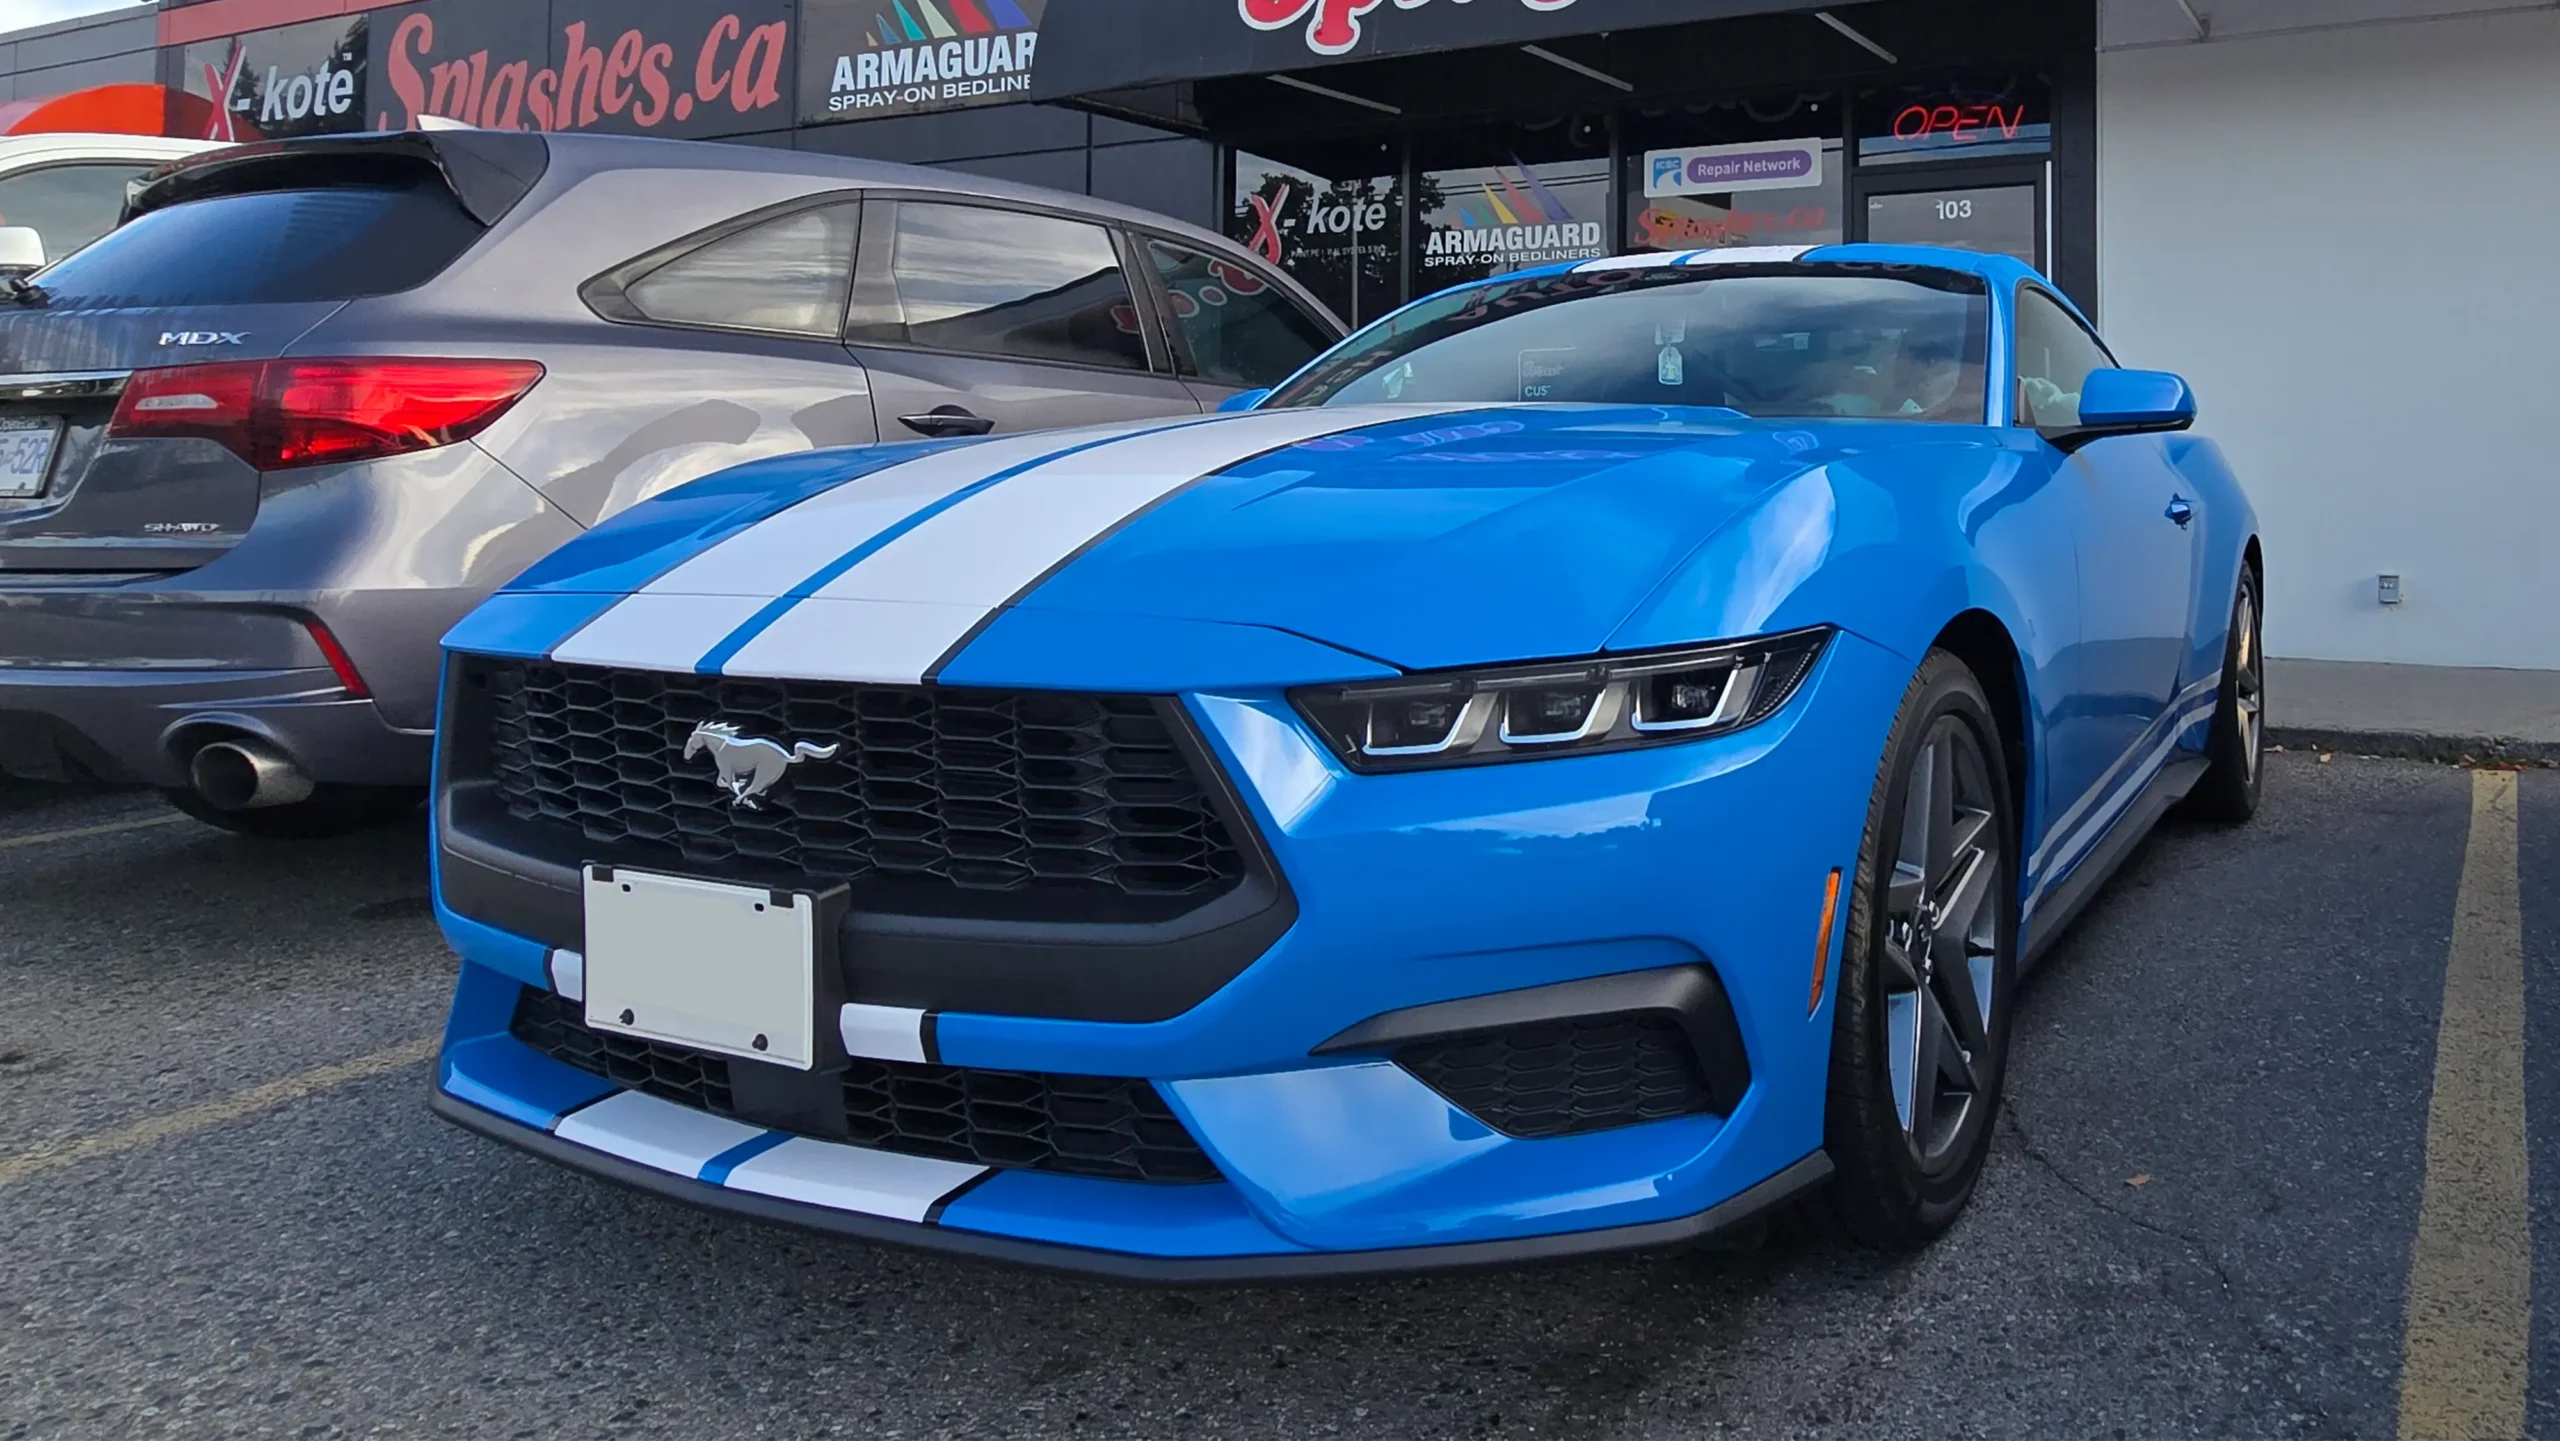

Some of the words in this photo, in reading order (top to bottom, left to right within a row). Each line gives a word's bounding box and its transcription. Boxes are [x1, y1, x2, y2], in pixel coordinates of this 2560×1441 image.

[378, 13, 787, 132] Splashes.ca
[831, 32, 1038, 92] ARMAGUAR
[260, 60, 354, 122] kote
[829, 86, 936, 111] SPRAY-ON
[943, 74, 1031, 99] BEDLINE
[1894, 105, 2024, 140] OPEN
[1698, 162, 1741, 177] Repair
[1744, 158, 1801, 173] Network
[1306, 196, 1387, 234] kote
[1935, 199, 1972, 220] 103
[1425, 222, 1601, 256] ARMAGUARD
[1424, 252, 1504, 268] SPRAY-ON
[1509, 247, 1601, 263] BEDLINERS
[158, 331, 252, 346] MDX
